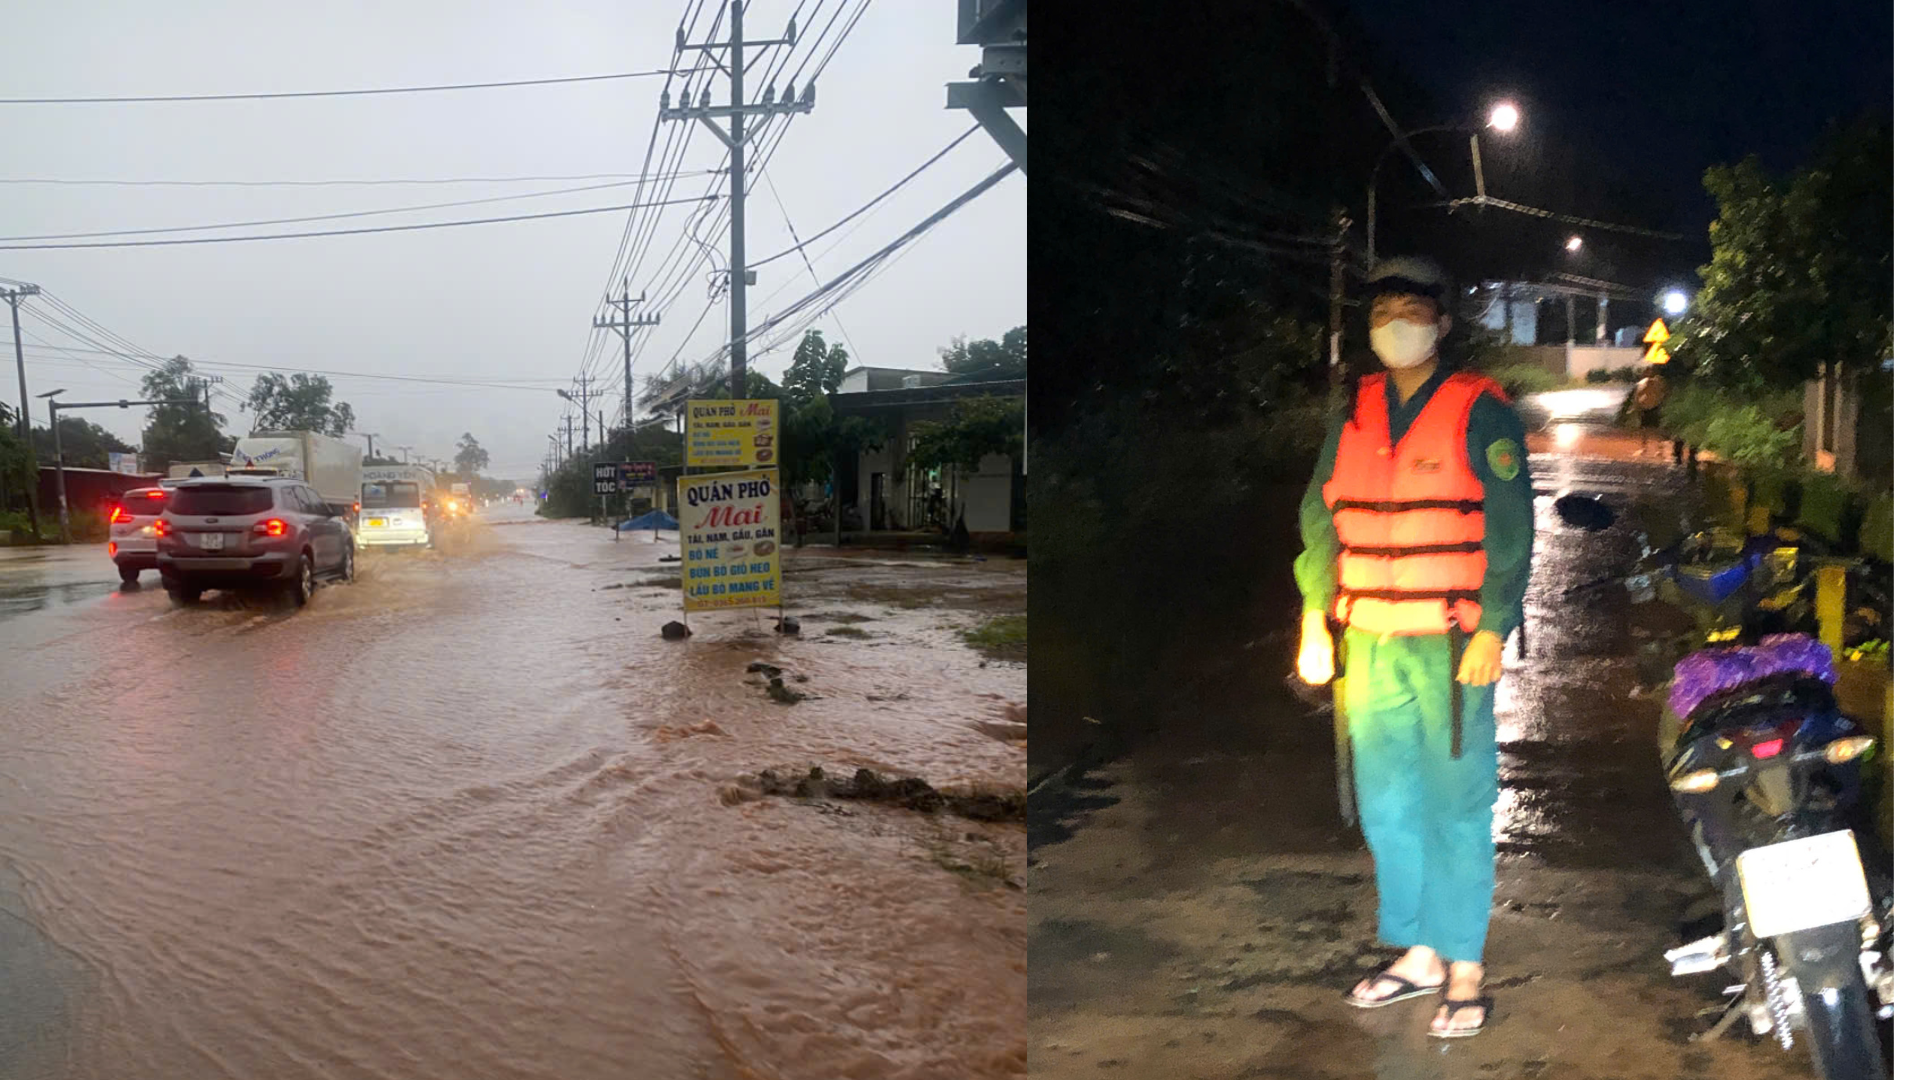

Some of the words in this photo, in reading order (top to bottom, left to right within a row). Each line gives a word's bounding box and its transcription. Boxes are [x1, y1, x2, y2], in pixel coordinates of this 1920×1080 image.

[737, 473, 771, 499] PHỞ
[693, 502, 765, 530] Mai
[750, 561, 770, 574] HEO
[728, 580, 760, 593] MANG
